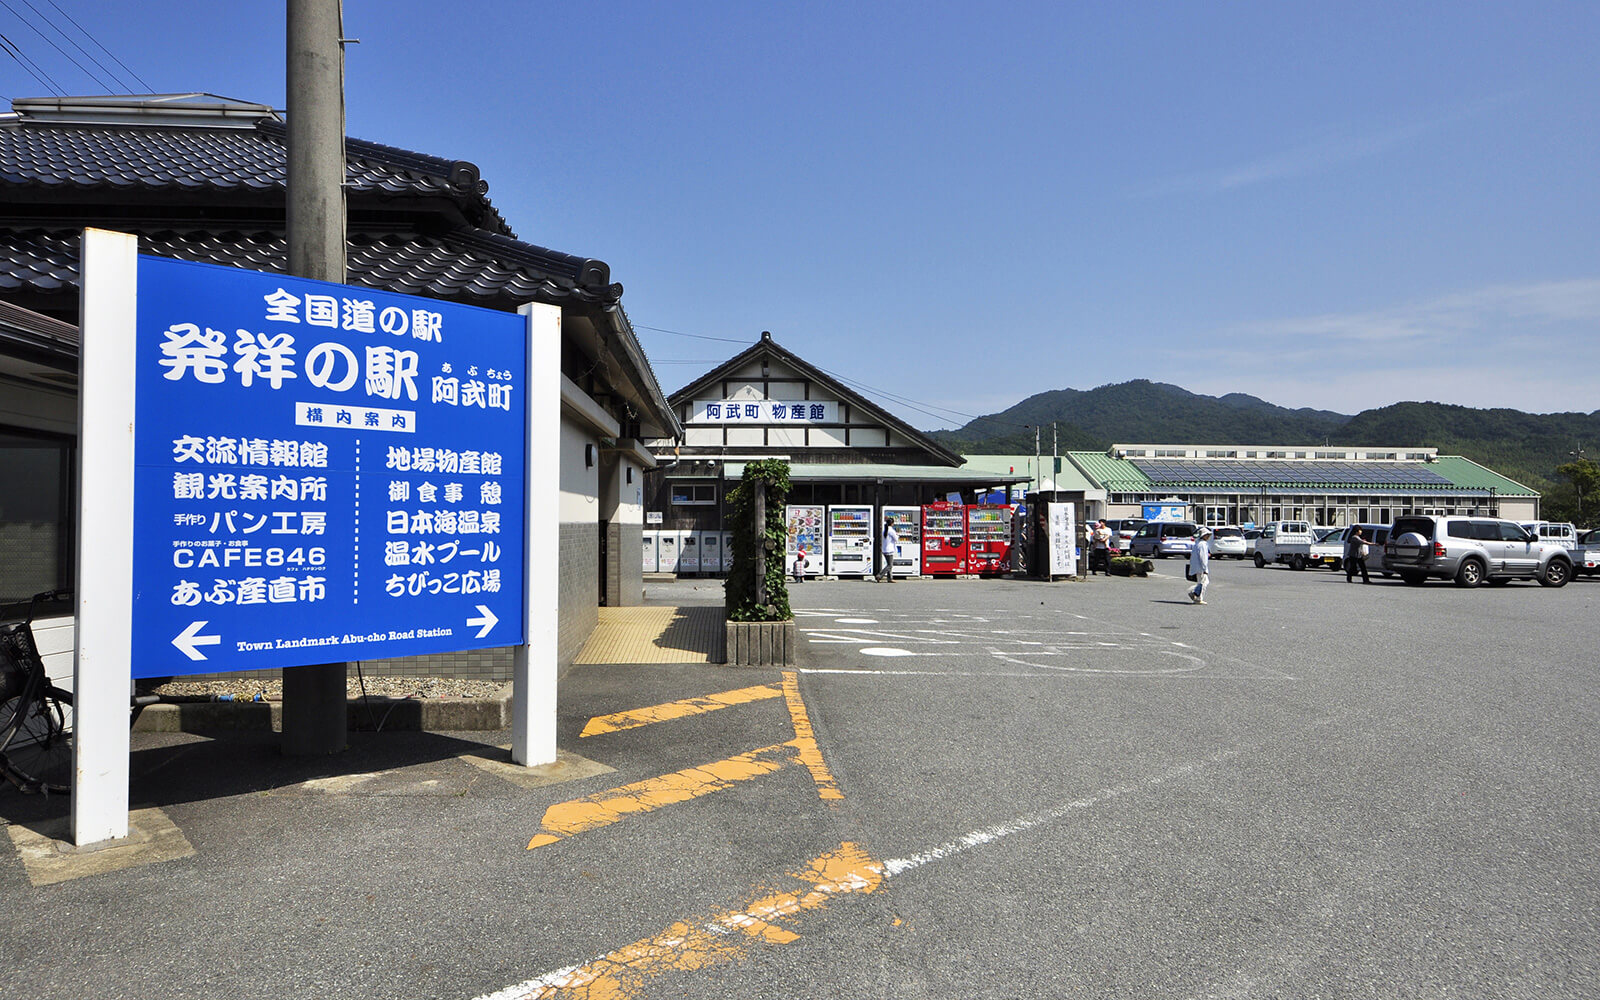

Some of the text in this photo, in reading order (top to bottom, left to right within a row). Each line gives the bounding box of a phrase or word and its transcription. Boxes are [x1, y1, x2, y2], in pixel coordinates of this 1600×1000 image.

[264, 288, 442, 342] 全国道の駅
[159, 321, 420, 402] 発祥の駅
[442, 362, 512, 380] あ ぶ ちょう
[432, 376, 513, 411] 阿武町
[306, 407, 406, 429] 構内案内
[707, 403, 826, 420] 阿武町 物産館
[173, 435, 328, 467] 交流情報館
[386, 446, 502, 474] 地場物産館
[173, 472, 327, 501] 観光案内所
[389, 481, 501, 504] 御食事 憩
[174, 510, 326, 535] 手作り パン工房
[387, 510, 500, 534] 日本海温泉
[174, 546, 325, 568] CAFE846
[385, 540, 500, 566] 温水プール
[171, 576, 326, 606] あぶ産直市
[386, 569, 501, 597] ちびっこ広場
[237, 628, 452, 651] Town Landmark Abu-cho Road Station
